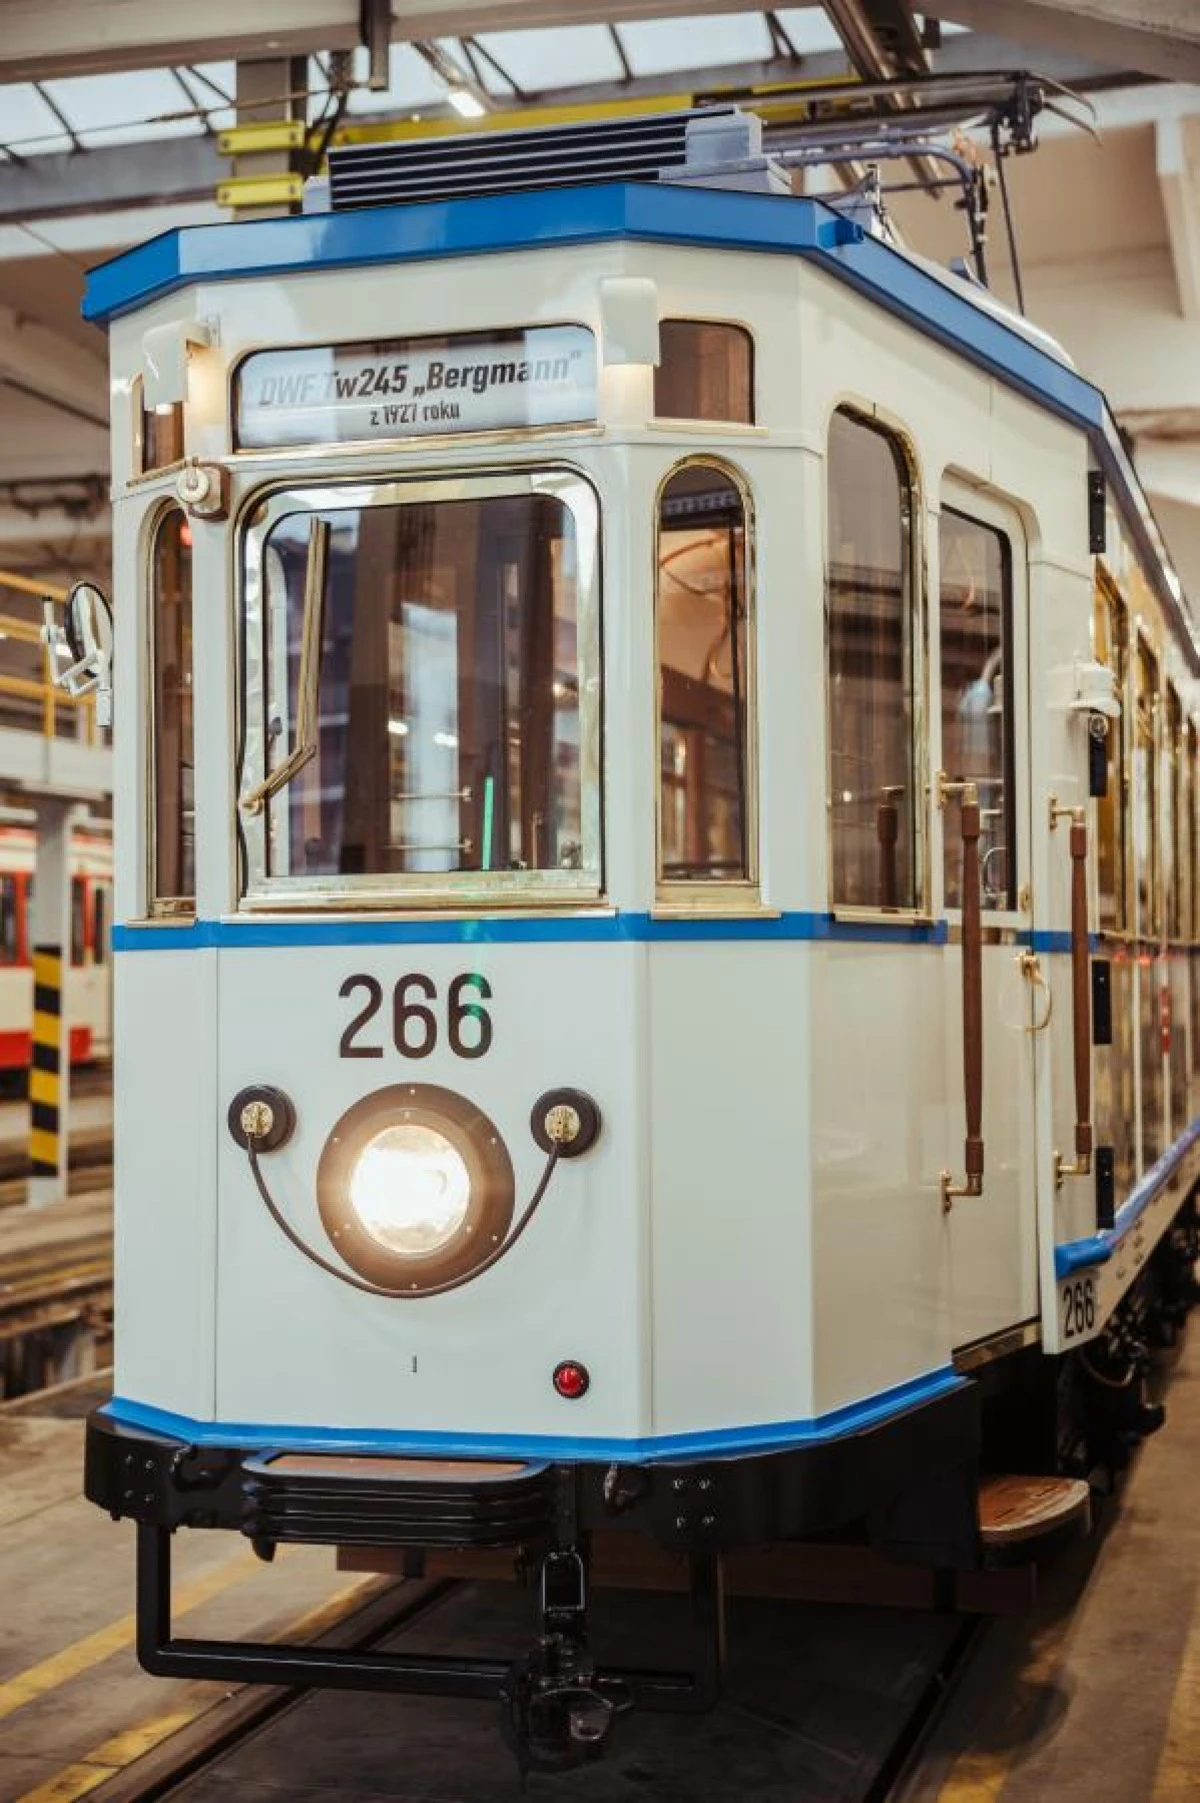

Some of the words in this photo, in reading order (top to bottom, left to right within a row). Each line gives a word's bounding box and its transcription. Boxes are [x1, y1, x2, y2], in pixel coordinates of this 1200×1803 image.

[258, 373, 316, 406] DWF
[370, 410, 379, 426] z
[383, 404, 417, 425] 1927
[423, 400, 460, 421] roku
[338, 973, 493, 1059] 266
[1063, 1279, 1094, 1338] 266
